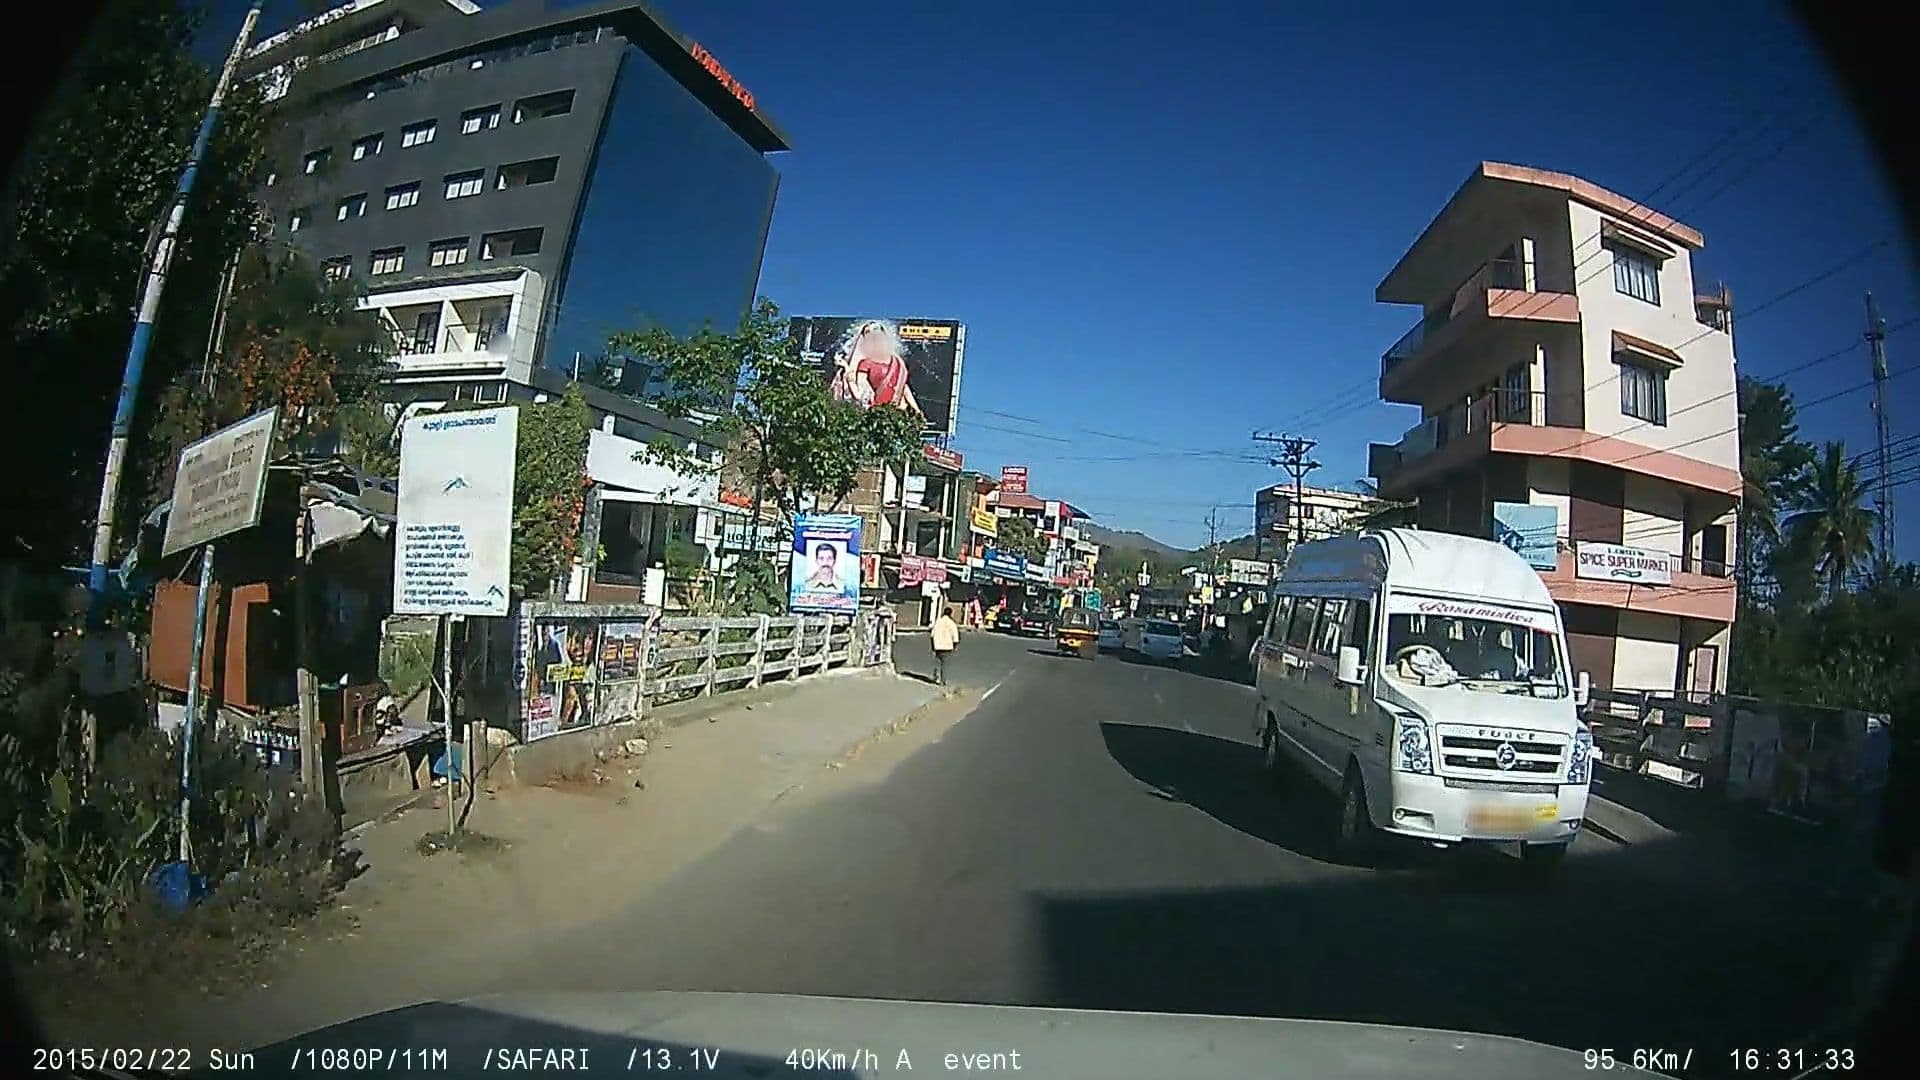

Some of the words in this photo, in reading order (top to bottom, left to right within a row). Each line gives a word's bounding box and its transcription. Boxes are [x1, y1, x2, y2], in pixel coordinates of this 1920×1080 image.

[1579, 551, 1605, 567] SPICE
[1607, 554, 1636, 569] SUPER
[1637, 557, 1669, 573] MARKET
